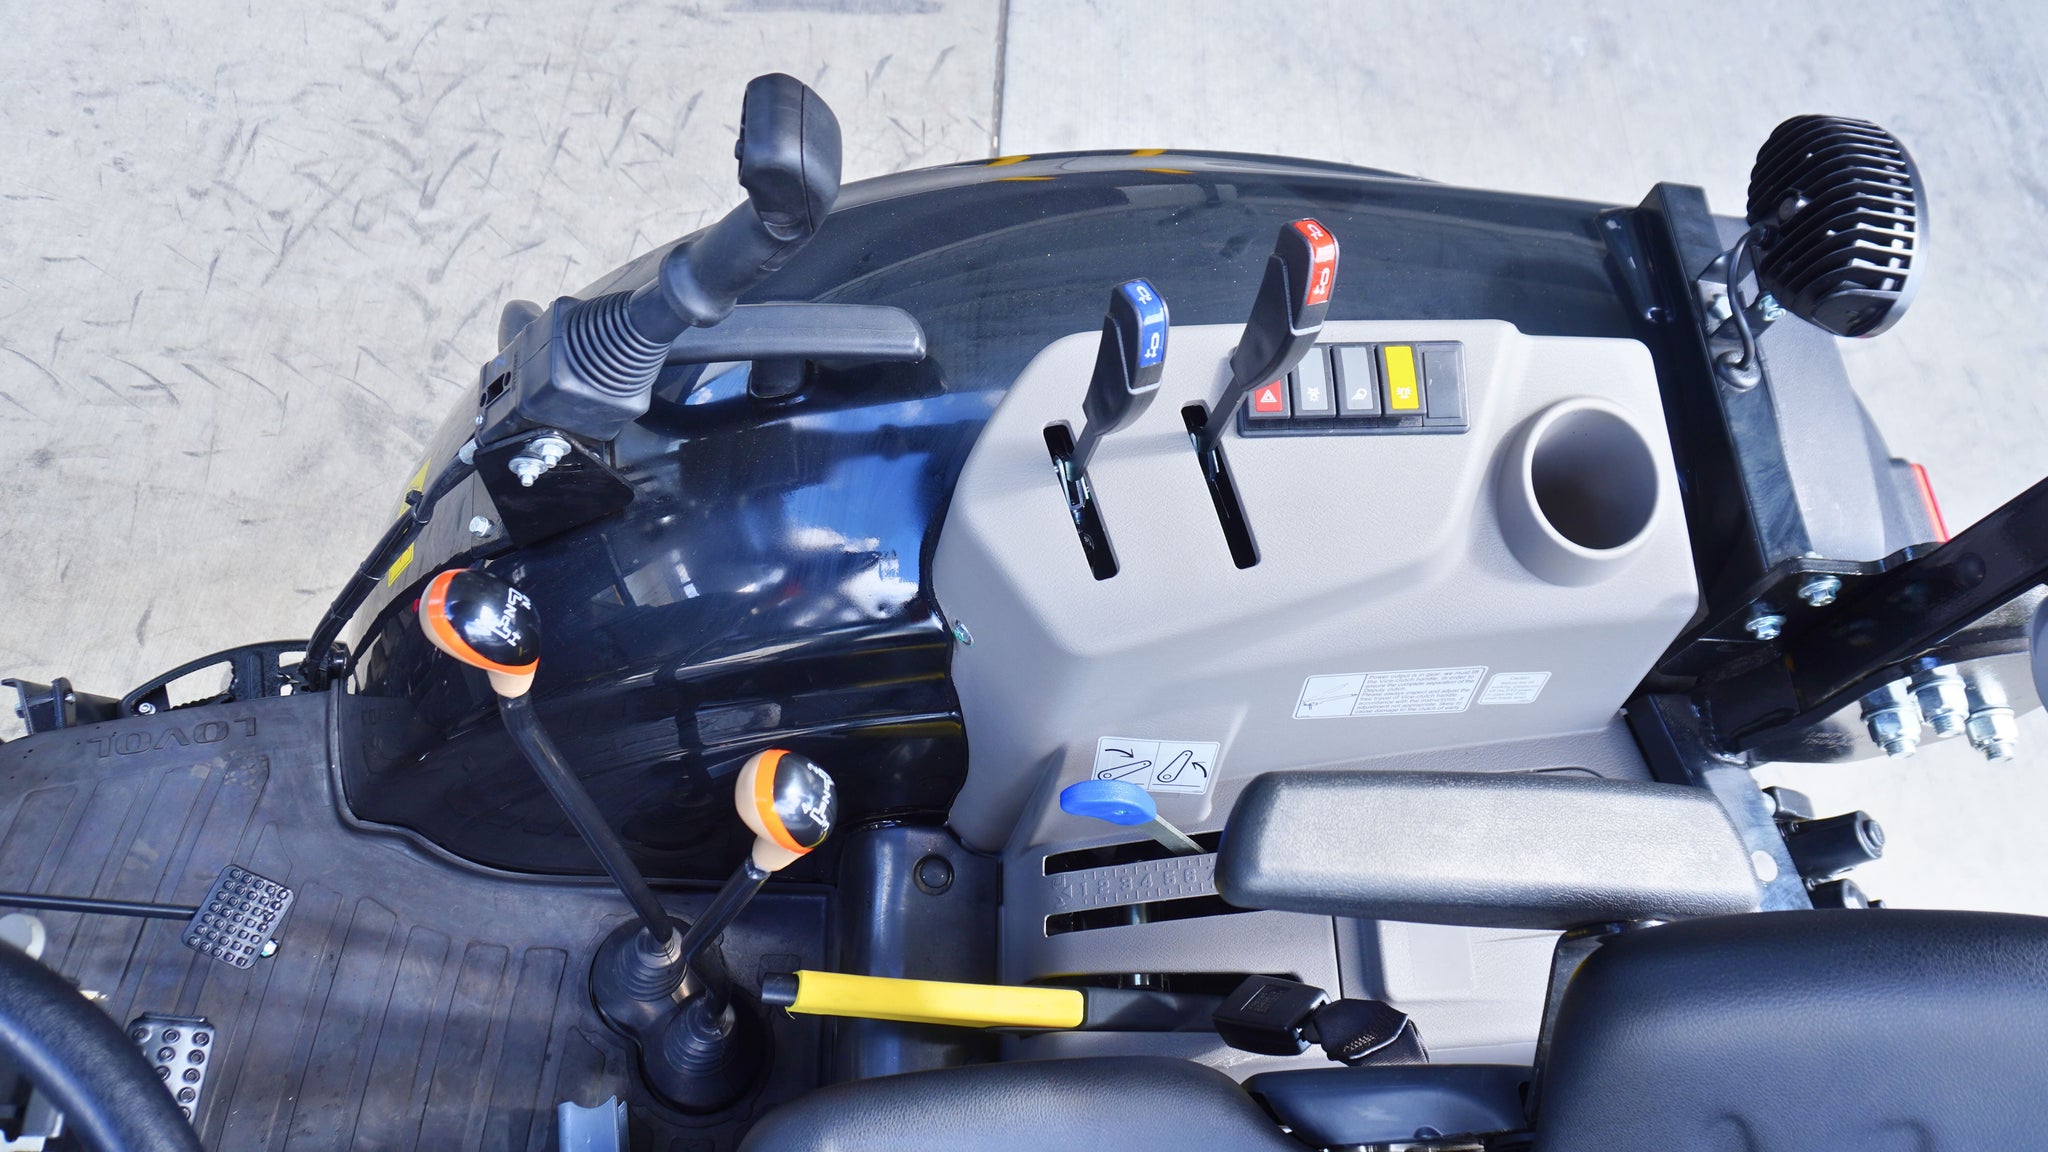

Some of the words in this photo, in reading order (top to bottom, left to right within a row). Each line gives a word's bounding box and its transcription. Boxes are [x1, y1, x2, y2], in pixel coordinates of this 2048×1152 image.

[507, 632, 521, 646] H
[87, 716, 257, 758] LOVOL
[1098, 879, 1110, 894] 2
[1120, 876, 1133, 891] 3
[1141, 873, 1153, 888] 4
[1164, 871, 1177, 885] 5
[1184, 868, 1197, 883] 6
